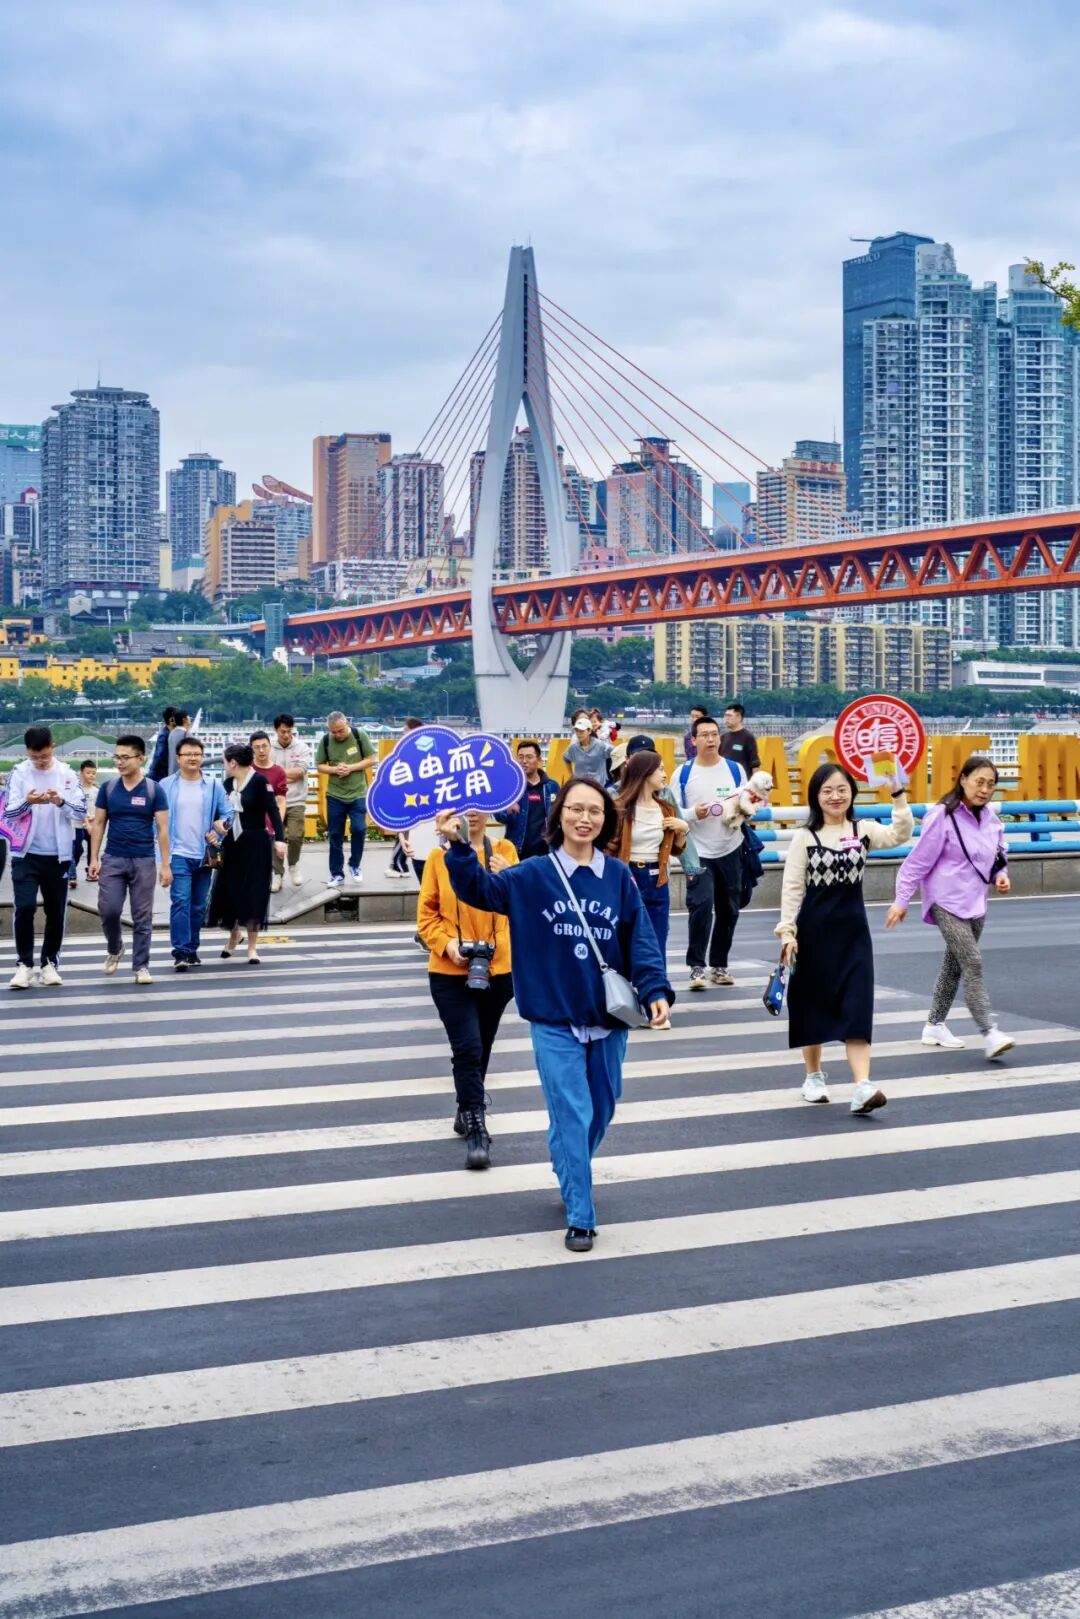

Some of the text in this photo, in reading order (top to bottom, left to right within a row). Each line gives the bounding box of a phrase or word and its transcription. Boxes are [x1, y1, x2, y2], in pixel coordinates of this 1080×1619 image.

[389, 744, 476, 786] 自由而
[433, 769, 492, 804] 无用
